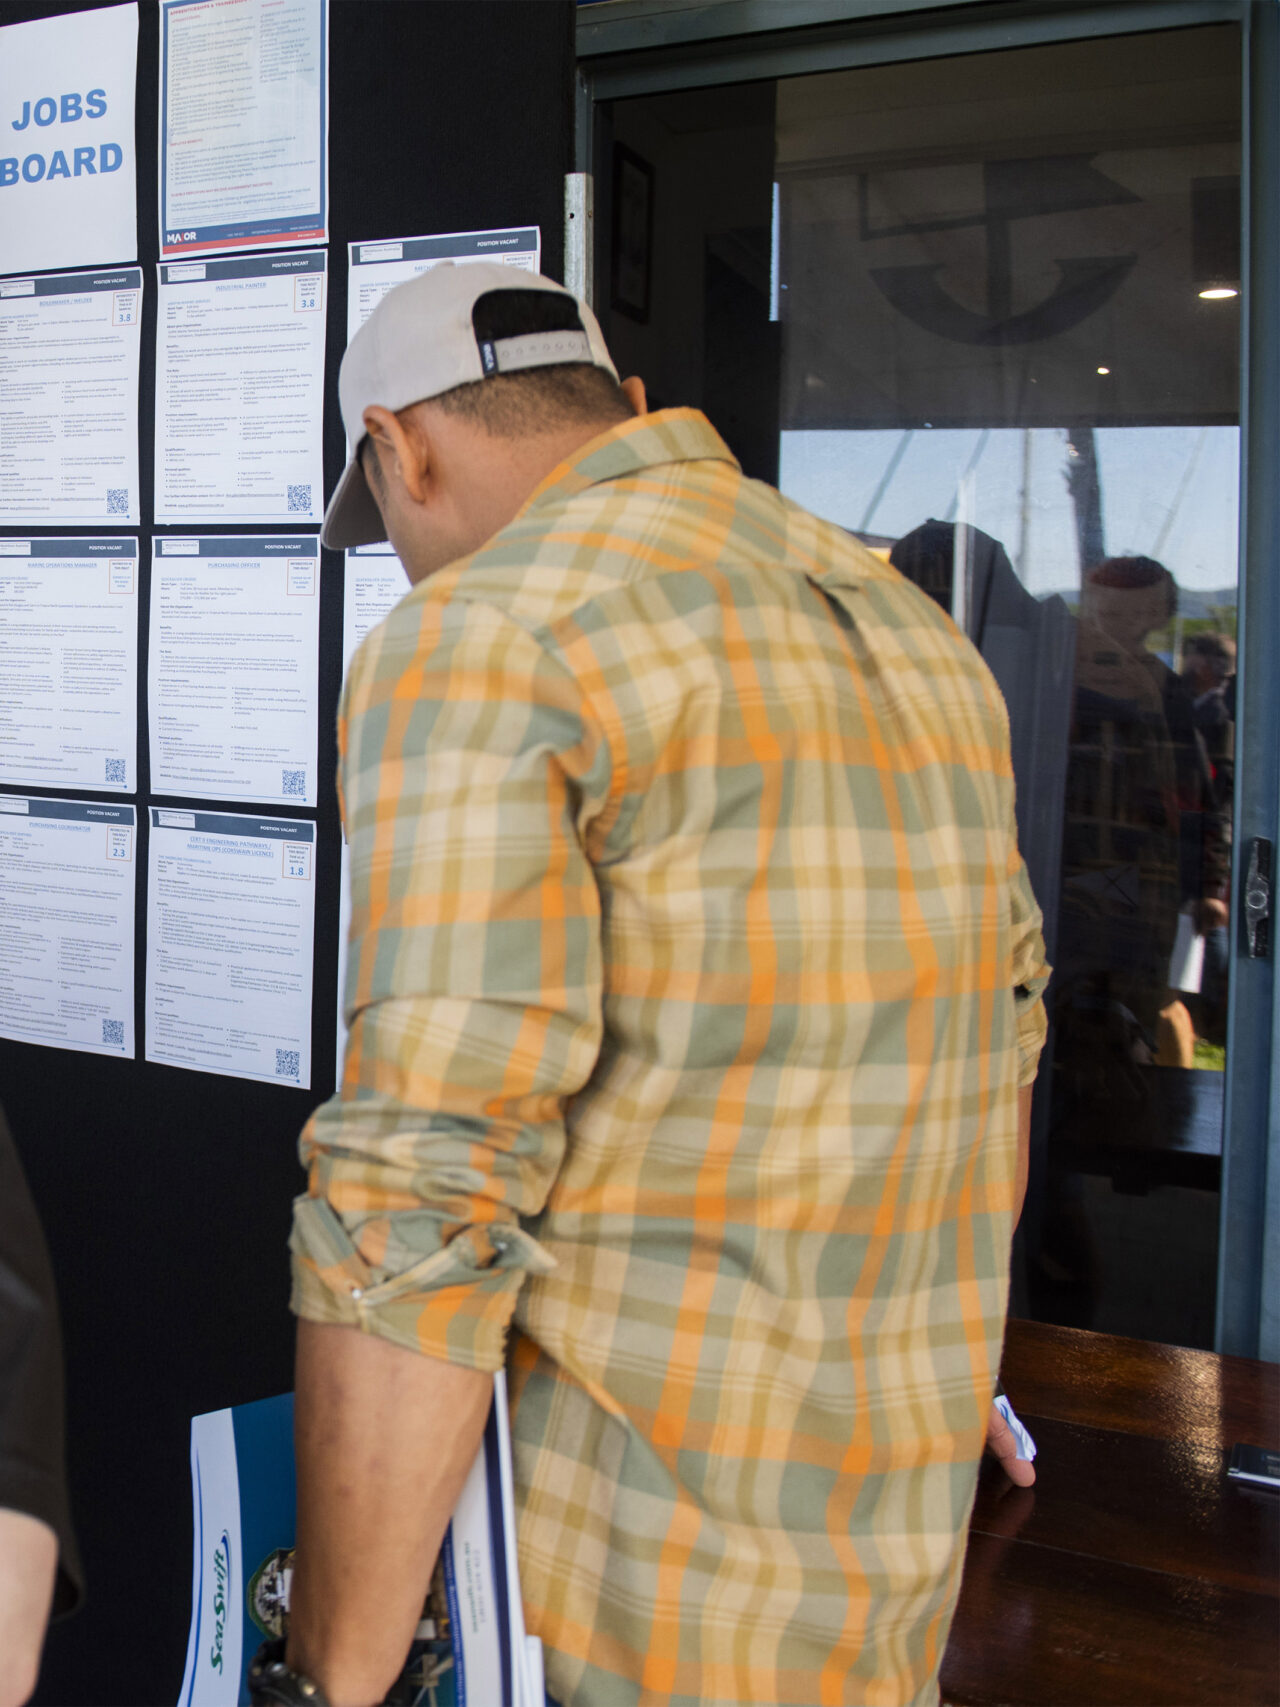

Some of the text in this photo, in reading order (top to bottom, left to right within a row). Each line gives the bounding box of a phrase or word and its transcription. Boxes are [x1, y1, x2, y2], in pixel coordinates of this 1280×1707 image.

[12, 89, 107, 131] JOBS
[500, 238, 519, 246] VACANT
[301, 298, 315, 308] 3.8
[119, 314, 131, 322] 3.8
[206, 838, 239, 847] ENGINEERING
[239, 841, 266, 849] PATHWAYS
[113, 848, 126, 858] 2.3
[290, 867, 304, 876] 1.8
